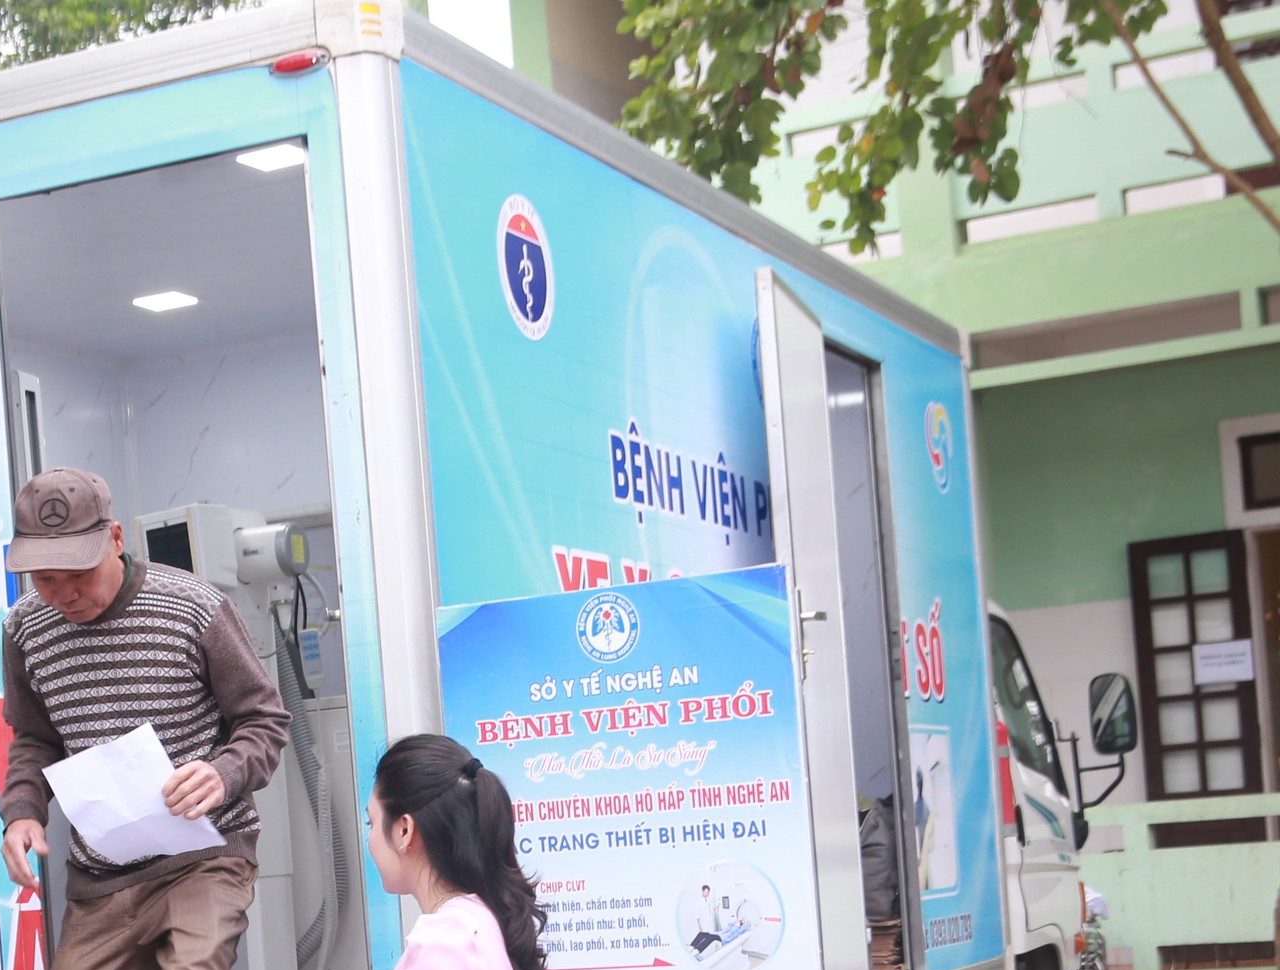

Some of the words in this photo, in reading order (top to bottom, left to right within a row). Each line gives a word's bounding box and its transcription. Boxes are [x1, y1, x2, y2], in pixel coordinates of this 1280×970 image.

[610, 420, 685, 525] BỆNH
[691, 451, 748, 547] VIỆN
[914, 601, 944, 698] SỐ
[529, 674, 557, 702] SỞ
[562, 679, 575, 698] Y
[580, 668, 604, 697] TẾ
[606, 664, 663, 694] NGHỆ
[668, 665, 699, 686] AN
[476, 711, 572, 748] BỆNH
[582, 698, 668, 736] VIỆN
[680, 680, 772, 723] PHỔI
[538, 793, 591, 822] CHUYÊN
[595, 794, 631, 818] KHOA
[635, 788, 654, 813] HÔ
[657, 782, 685, 812] HẤP
[689, 782, 722, 809] TỈNH
[726, 778, 765, 808] NGHỆ
[769, 780, 790, 802] AN
[538, 833, 600, 853] TRANG
[605, 821, 653, 848] THIẾT
[658, 827, 676, 849] BỊ
[682, 819, 726, 846] HIỆN
[731, 819, 767, 843] ĐẠI
[540, 881, 563, 896] CHỤP
[566, 880, 586, 892] CLVT
[609, 897, 632, 910] đoán
[633, 895, 653, 908] sớm
[618, 917, 624, 929] U
[570, 940, 584, 951] lao
